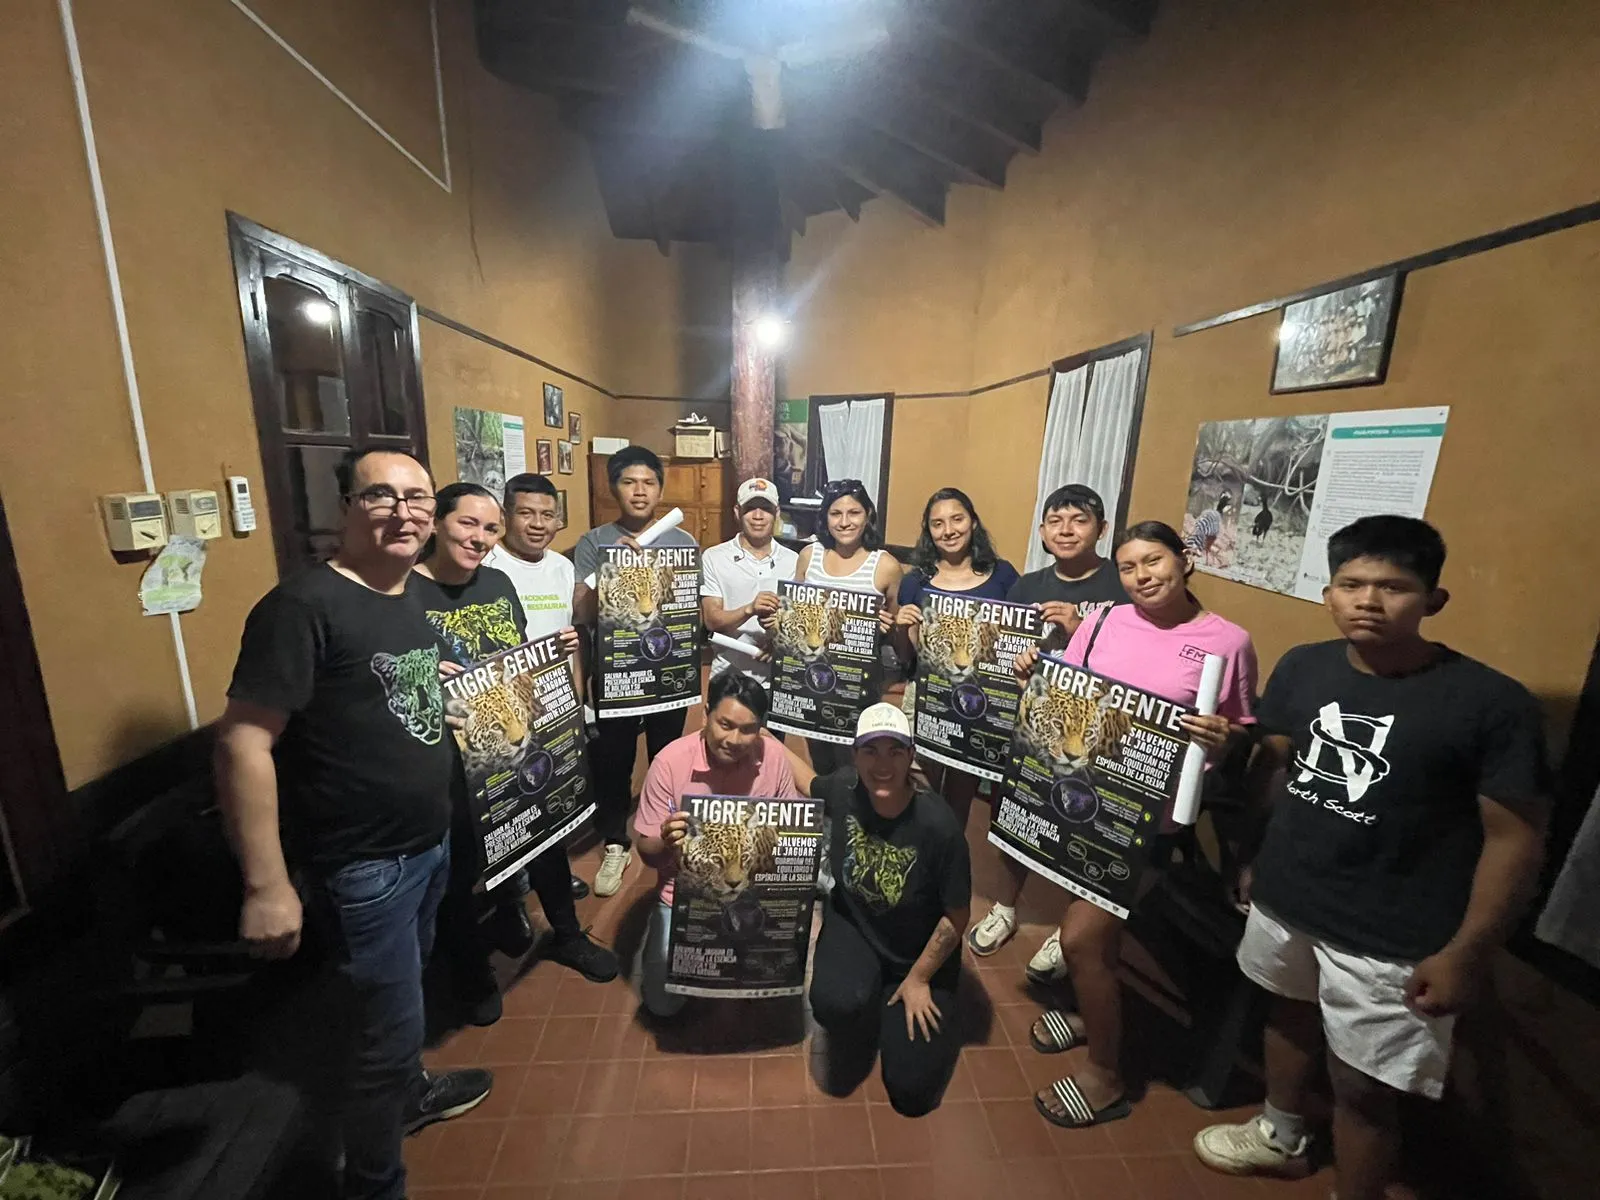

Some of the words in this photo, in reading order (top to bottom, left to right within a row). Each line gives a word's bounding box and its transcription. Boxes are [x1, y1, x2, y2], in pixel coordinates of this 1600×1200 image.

[606, 548, 653, 568] TIGRE
[657, 548, 696, 567] GENTE
[784, 584, 825, 605] TIGRE
[830, 590, 876, 614] GENTE
[929, 594, 974, 618] TIGRE
[980, 602, 1036, 630] GENTE
[993, 641, 1002, 650] AL
[1003, 642, 1026, 654] JAGUA
[999, 634, 1036, 647] SALVEMOS
[444, 661, 498, 700] TIGRE
[503, 638, 558, 679] GENTE
[534, 666, 566, 688] SALVEMOS
[534, 688, 542, 698] AL
[542, 675, 570, 694] JAGUAR:
[1042, 659, 1103, 699] TIGRE
[1110, 684, 1186, 732] GENTE
[1120, 734, 1132, 746] AL
[1134, 740, 1176, 763] JAGUAR:
[1130, 726, 1180, 754] SALVEMOS
[1122, 746, 1158, 768] GUARDIÁN
[1158, 760, 1172, 773] DEL
[1122, 757, 1164, 780] EQUILIBRIO
[1163, 772, 1170, 782] Y
[1096, 755, 1126, 774] ESPÍRITU
[1126, 769, 1136, 778] DE
[1135, 772, 1145, 782] LA
[1144, 776, 1166, 791] SELVA
[691, 799, 748, 824] TIGRE
[755, 801, 815, 827] GENTE
[1324, 800, 1376, 824] Scott
[772, 846, 782, 856] AL
[783, 846, 816, 856] JAGUAR:
[778, 836, 817, 848] SALVEMOS
